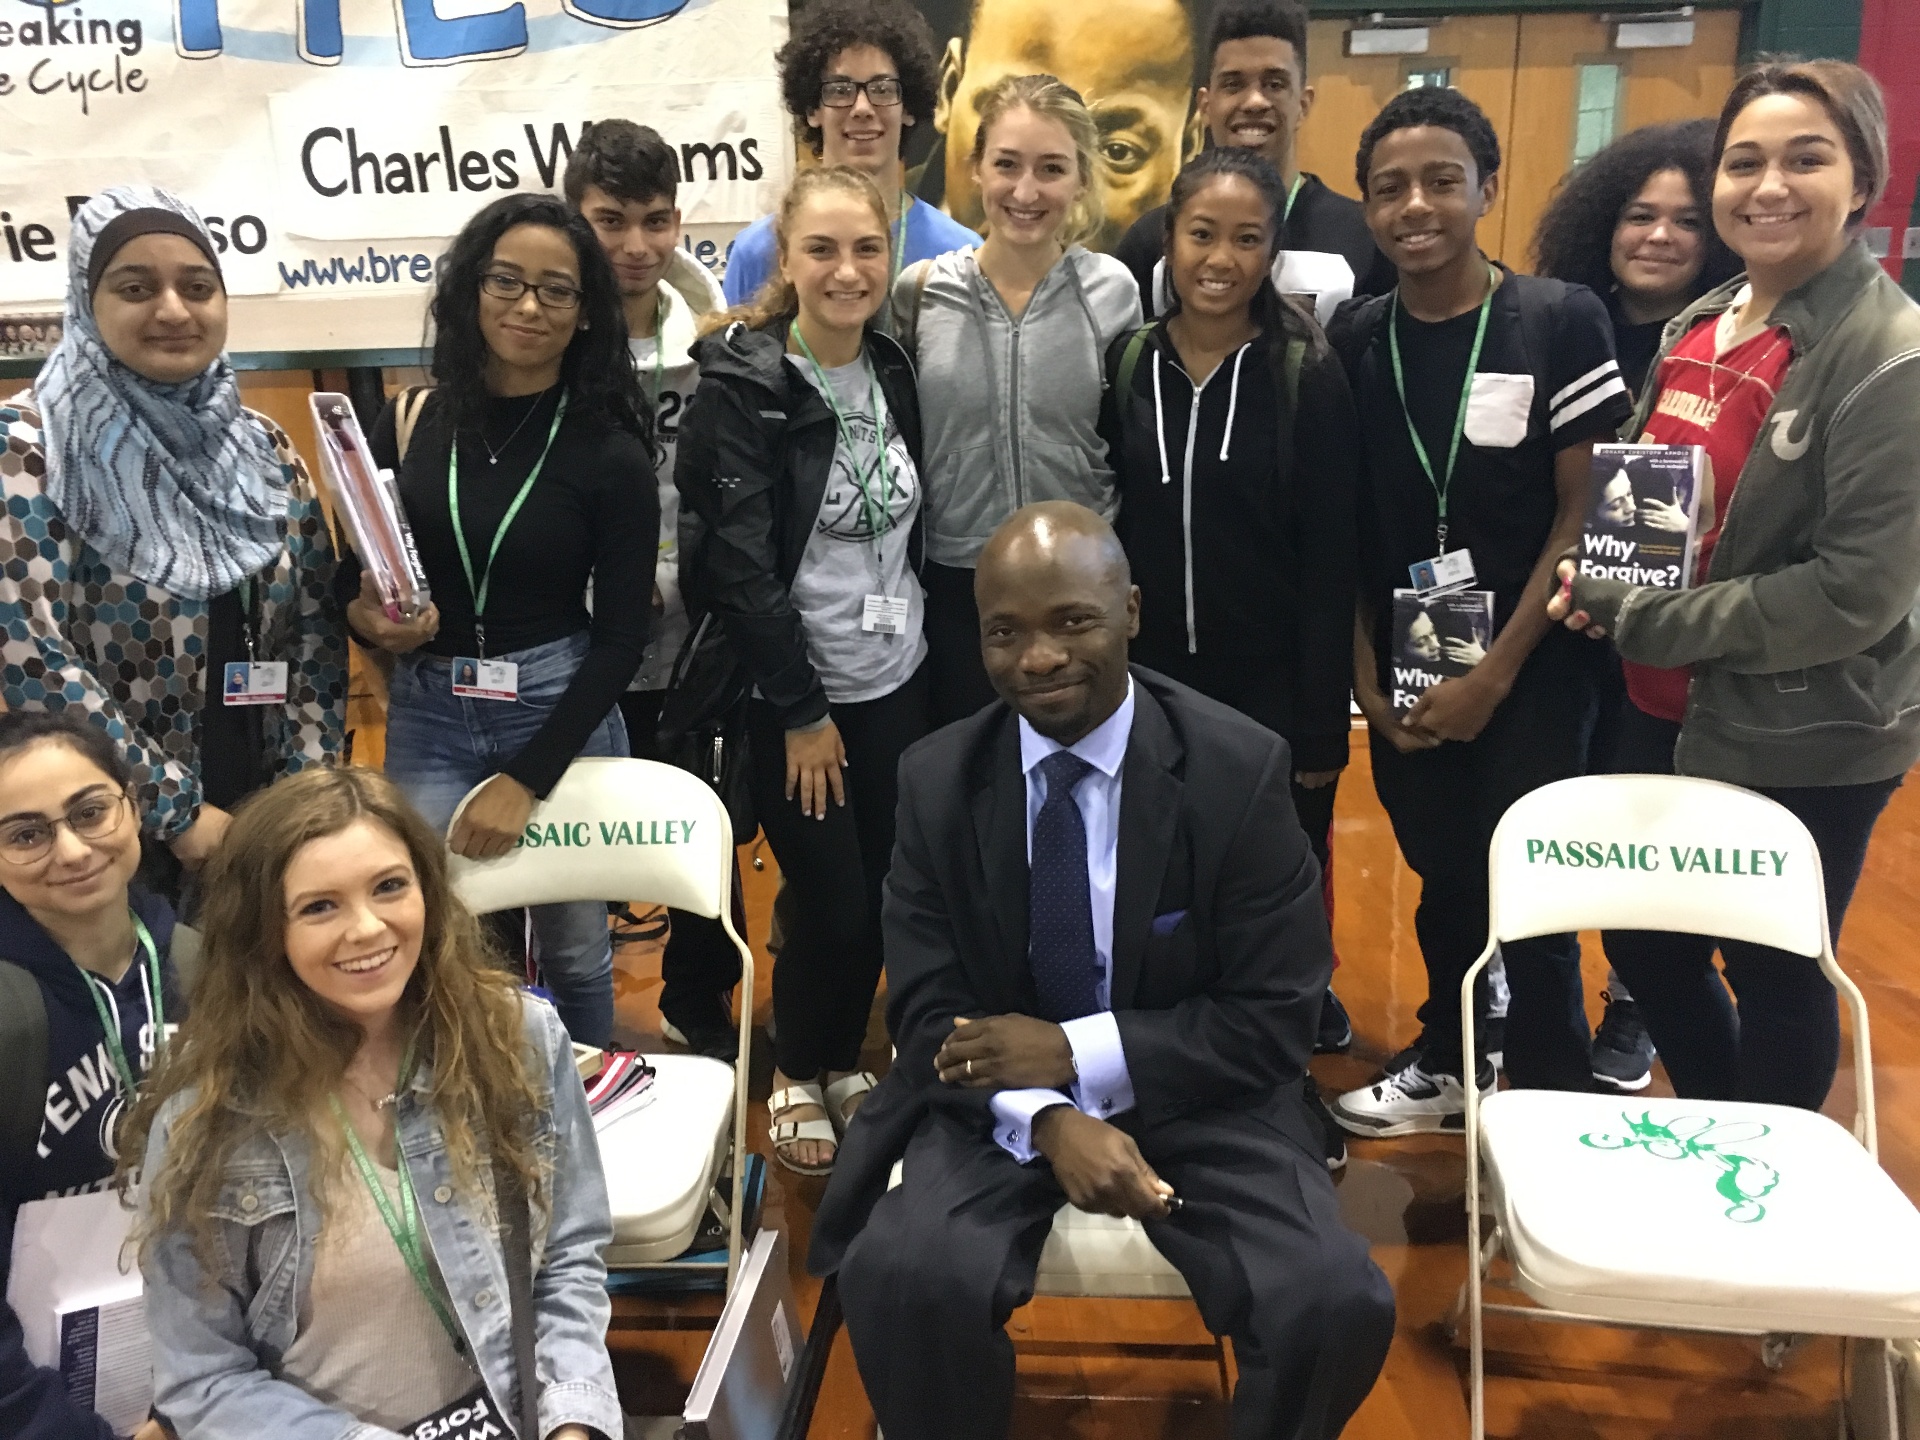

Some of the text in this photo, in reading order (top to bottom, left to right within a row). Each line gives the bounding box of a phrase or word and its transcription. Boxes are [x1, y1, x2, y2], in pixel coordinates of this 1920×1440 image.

[28, 54, 149, 116] Cycle
[301, 125, 519, 197] Charles
[0, 211, 57, 262] ie
[1584, 533, 1636, 562] Why
[1580, 559, 1680, 587] Forgive?
[599, 820, 696, 846] VALLEY
[1526, 839, 1789, 876] PASSAIC VALLEY
